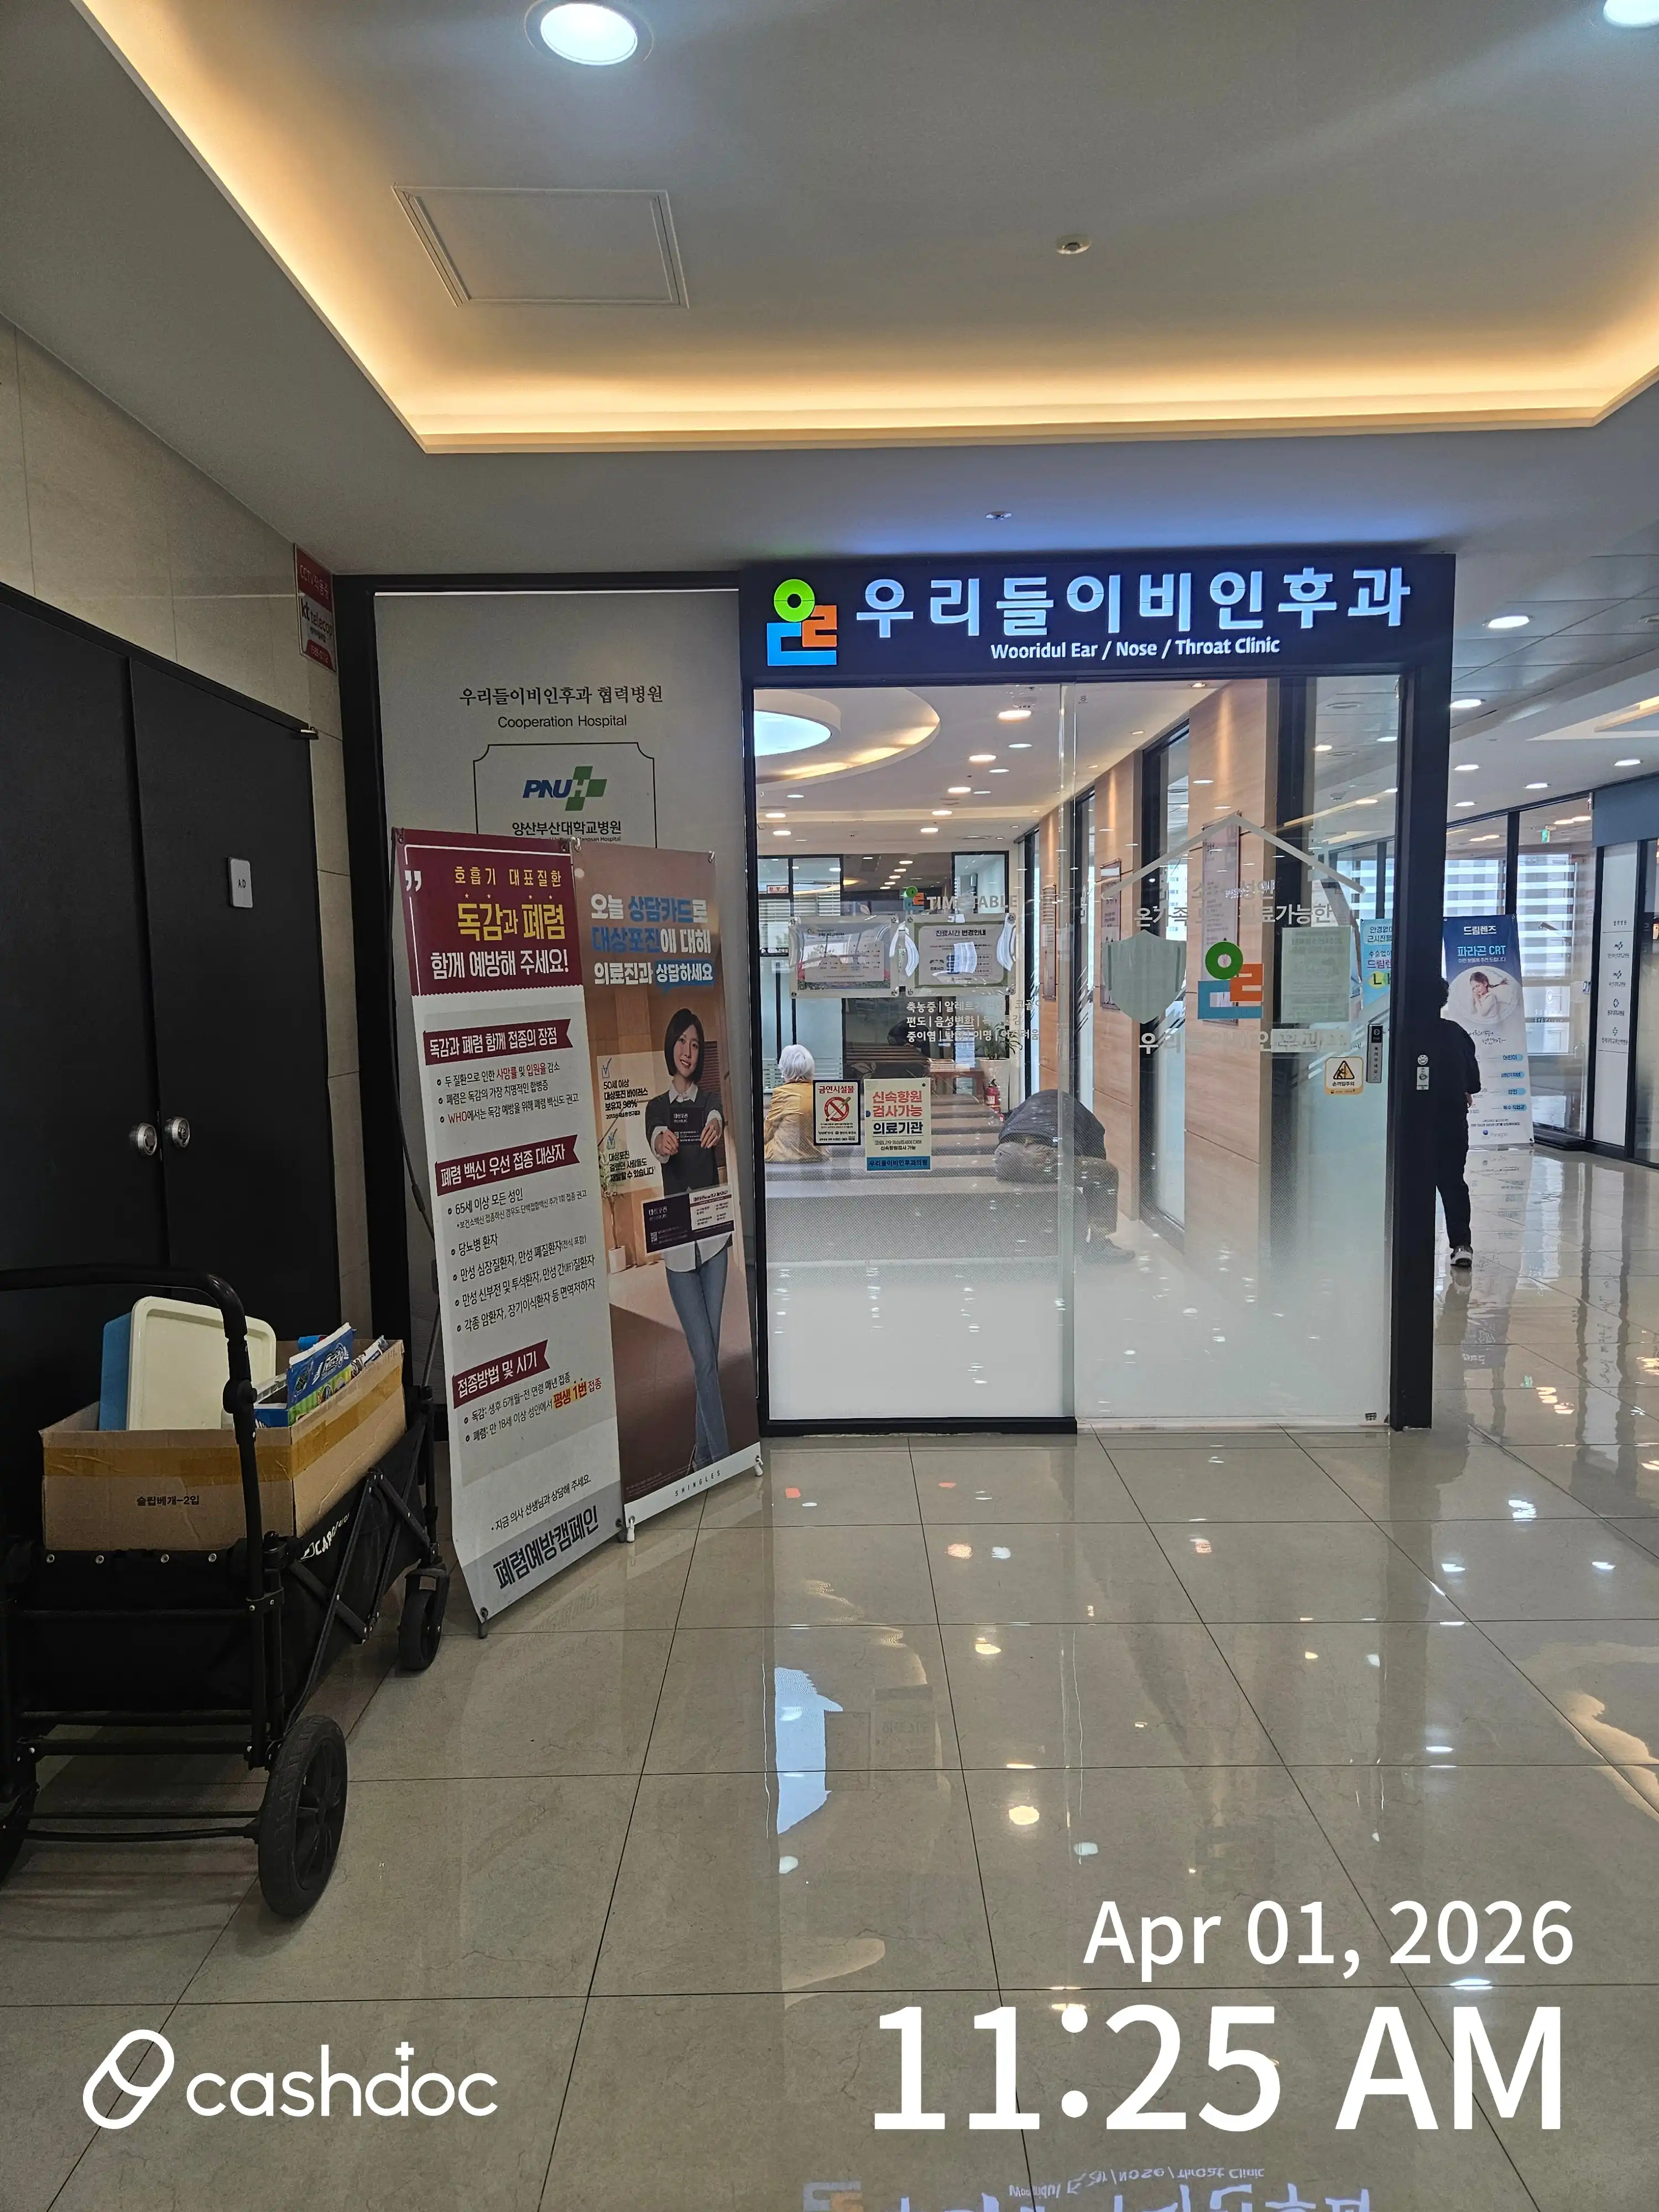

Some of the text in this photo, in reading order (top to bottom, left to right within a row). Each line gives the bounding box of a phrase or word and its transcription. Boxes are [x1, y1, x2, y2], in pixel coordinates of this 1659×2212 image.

[856, 566, 1411, 638] 우리들이비인후과
[990, 637, 1280, 659] Wooridul Ear Nose Throat Clinic
[460, 685, 663, 706] 우리들이비인후과 협력병원
[497, 715, 627, 729] Cooperation Hospital
[512, 820, 622, 836] 양산부산대학교병원
[455, 865, 562, 887] 호흡기 대표질환
[591, 893, 708, 923] 오늘 상담카드로
[457, 902, 566, 941] 독감과 폐렴
[1463, 925, 1497, 936] 드림렌즈
[591, 927, 711, 954] 대상포진에 대해
[1457, 945, 1506, 957] 파라곤 CRT
[431, 948, 569, 979] 함께 예방해 주세요!
[594, 962, 713, 985] 의료진과 상담하세요
[906, 1001, 936, 1013] 축농증
[906, 1016, 926, 1027] 편도
[430, 1026, 557, 1058] 독감과 폐렴 함께 접종의 장점
[906, 1030, 992, 1042] 중이염 이명
[445, 1061, 560, 1087] 두 질환으로 인한 사망률 및 입원율 감소
[603, 1078, 629, 1089] 50세 이상
[446, 1079, 549, 1105] 폐렴은 독감의 가장 치명적인 합병증
[604, 1087, 649, 1100] 대상포진 바이러스
[818, 1086, 855, 1094] 금연시설물
[872, 1091, 922, 1104] 신속항원
[448, 1093, 579, 1124] WHO에서는 독감 예방을 위해 폐렴 백신도 권고
[605, 1102, 622, 1112] 보유자
[873, 1105, 922, 1118] 검사가능
[873, 1121, 923, 1134] 의료기관
[441, 1143, 565, 1187] 폐렴 백신 우선 접종 대상자
[608, 1150, 630, 1162] 대상포진
[627, 1158, 648, 1169] 사람들도
[627, 1171, 633, 1180] 수
[633, 1166, 654, 1178] 있습니다
[455, 1187, 523, 1215] 65세 이상 모든 성인
[458, 1233, 498, 1256] 당뇨병 환자
[460, 1265, 475, 1282] 만성
[477, 1254, 518, 1276] 심장질환자,
[518, 1248, 533, 1264] 만성
[462, 1290, 477, 1307] 만성
[478, 1283, 501, 1301] 신부전
[503, 1281, 510, 1294] 및
[512, 1271, 542, 1291] 투석환자,
[542, 1265, 556, 1281] 만성
[465, 1277, 596, 1332] 각종 암환자, 장기이식환자 등 면역저하자
[457, 1350, 537, 1399] 접종방법 및 시기
[472, 1371, 571, 1422] 독감: 생후 연령 매년 접종
[473, 1377, 602, 1441] 폐렴: 만 18세 이상 성인에서 평생 1번 접종
[675, 1470, 721, 1496] SHINGLES
[495, 1515, 509, 1531] 지금
[510, 1507, 524, 1522] 의사
[525, 1494, 551, 1516] 선생님과
[551, 1483, 570, 1502] 상담해
[493, 1505, 599, 1589] 폐렴예방캠페인
